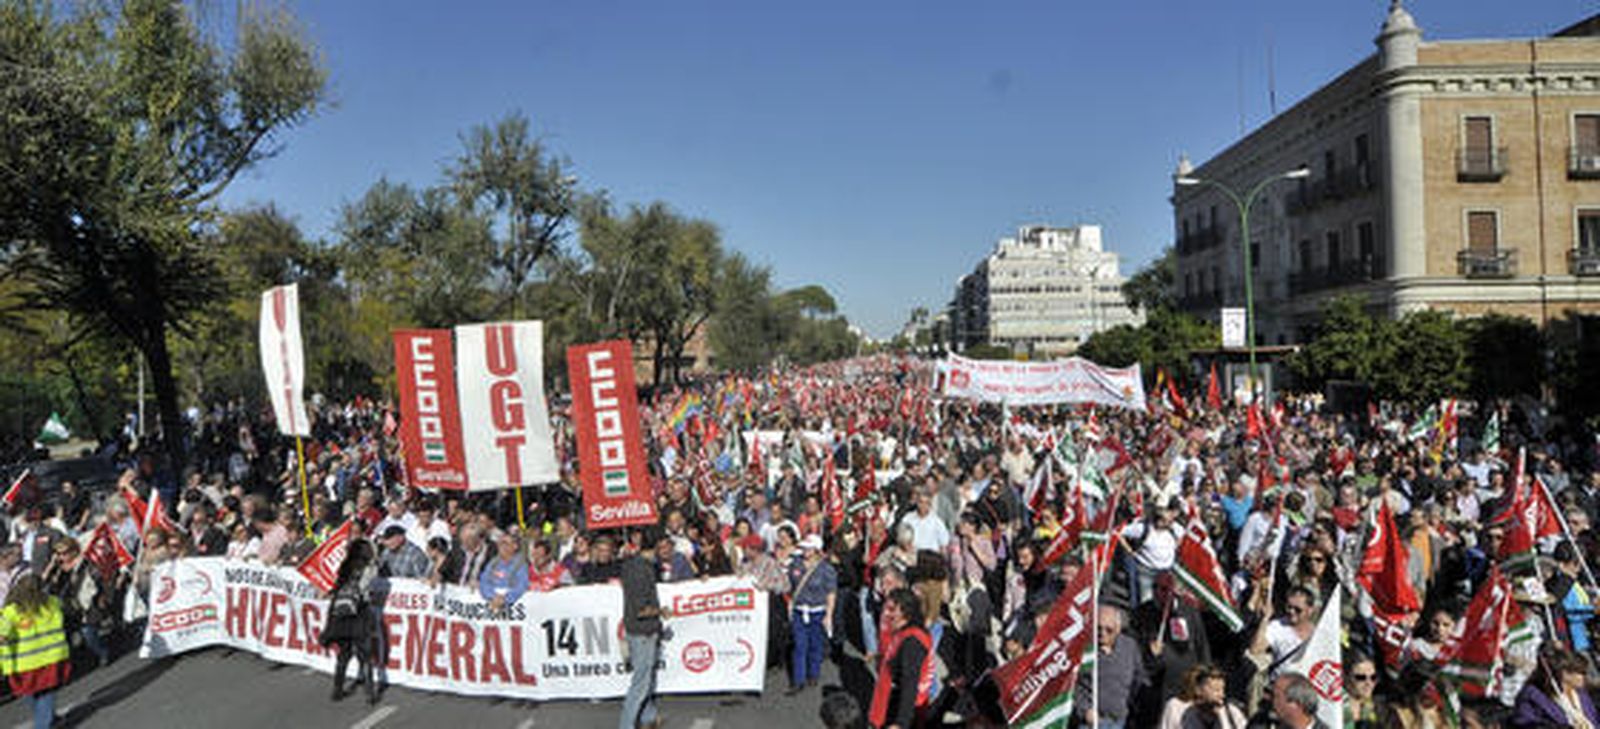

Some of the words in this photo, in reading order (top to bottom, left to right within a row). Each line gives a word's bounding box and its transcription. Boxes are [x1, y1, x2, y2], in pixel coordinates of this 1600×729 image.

[411, 336, 443, 439] CCOO
[484, 324, 526, 484] UGT
[587, 350, 627, 467] CCOO
[415, 467, 465, 484] Sevilla
[590, 500, 651, 522] Sevilla
[225, 586, 340, 656] HUELG
[383, 613, 538, 687] ENERAL
[541, 662, 569, 679] Una
[573, 661, 611, 677] tarea
